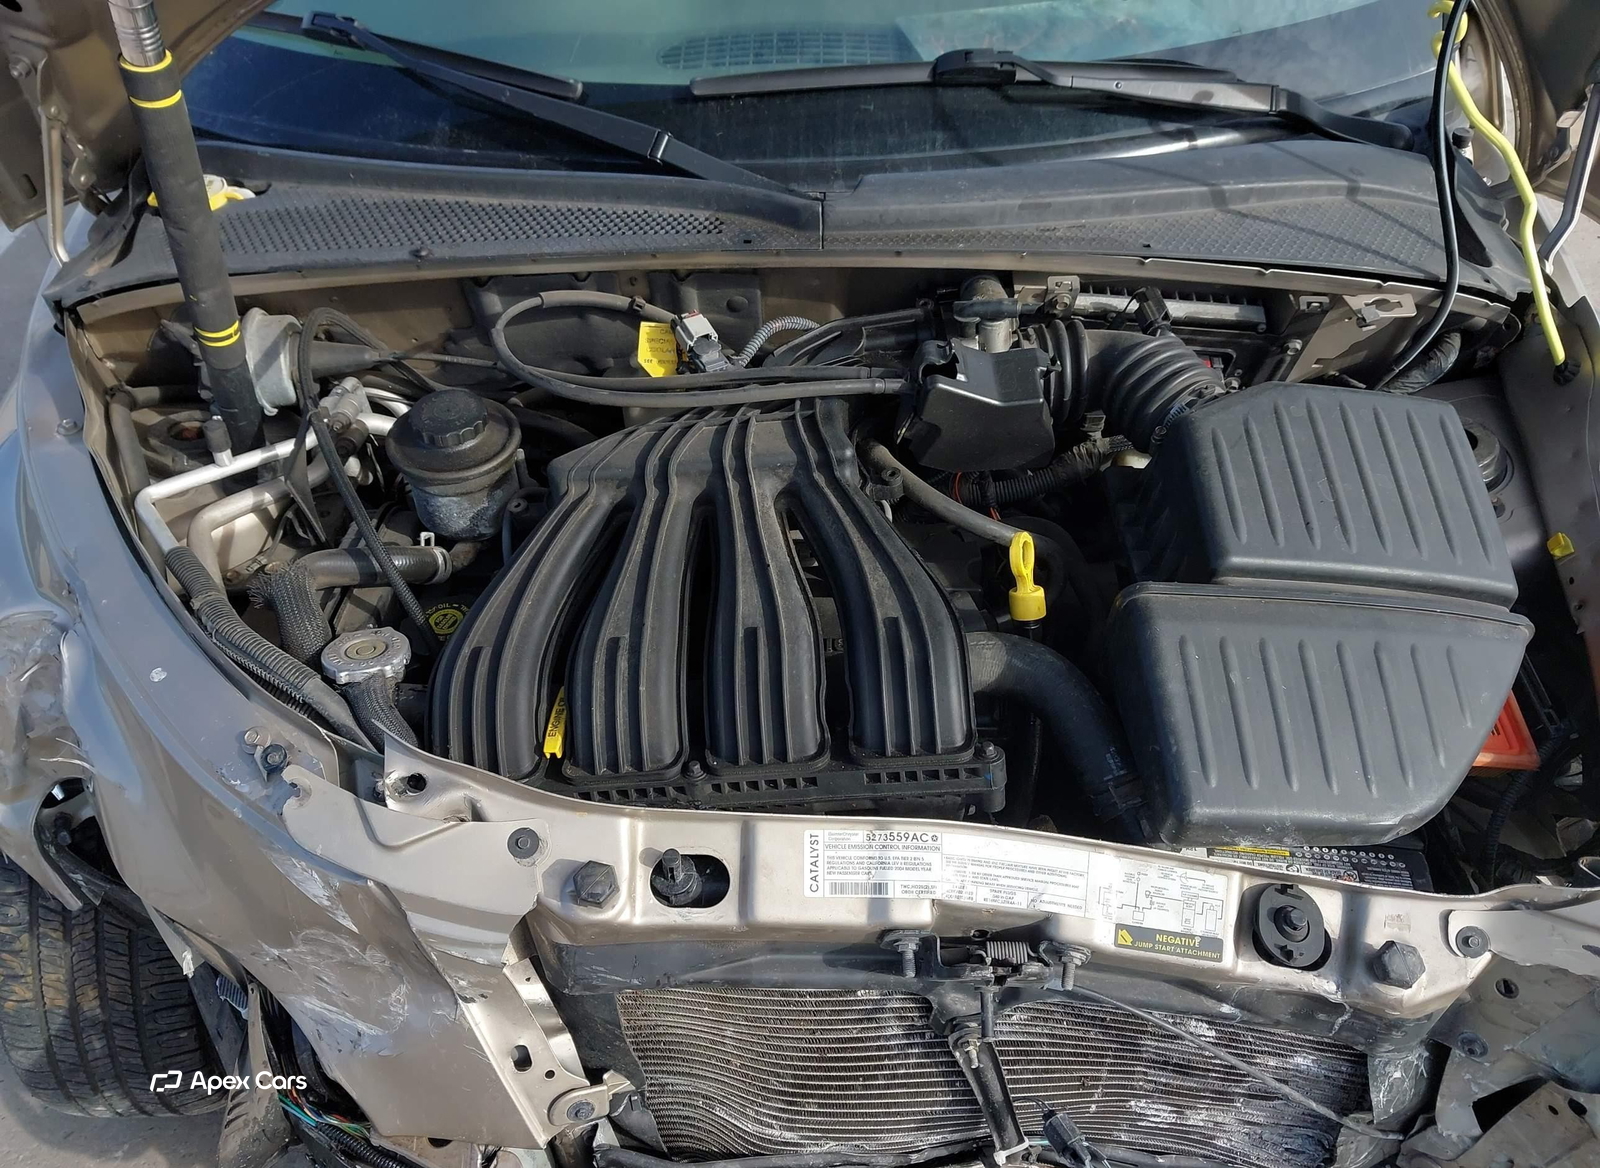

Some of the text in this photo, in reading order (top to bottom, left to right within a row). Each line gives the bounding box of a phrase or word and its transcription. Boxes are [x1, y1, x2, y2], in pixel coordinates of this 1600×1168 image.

[548, 708, 564, 738] ENGINE
[865, 832, 929, 842] 5273559AC
[810, 834, 819, 892] CATALYST
[1156, 934, 1200, 947] NEGATIVE
[1134, 941, 1153, 950] JUMP
[1176, 948, 1220, 958] ATTACHMENT
